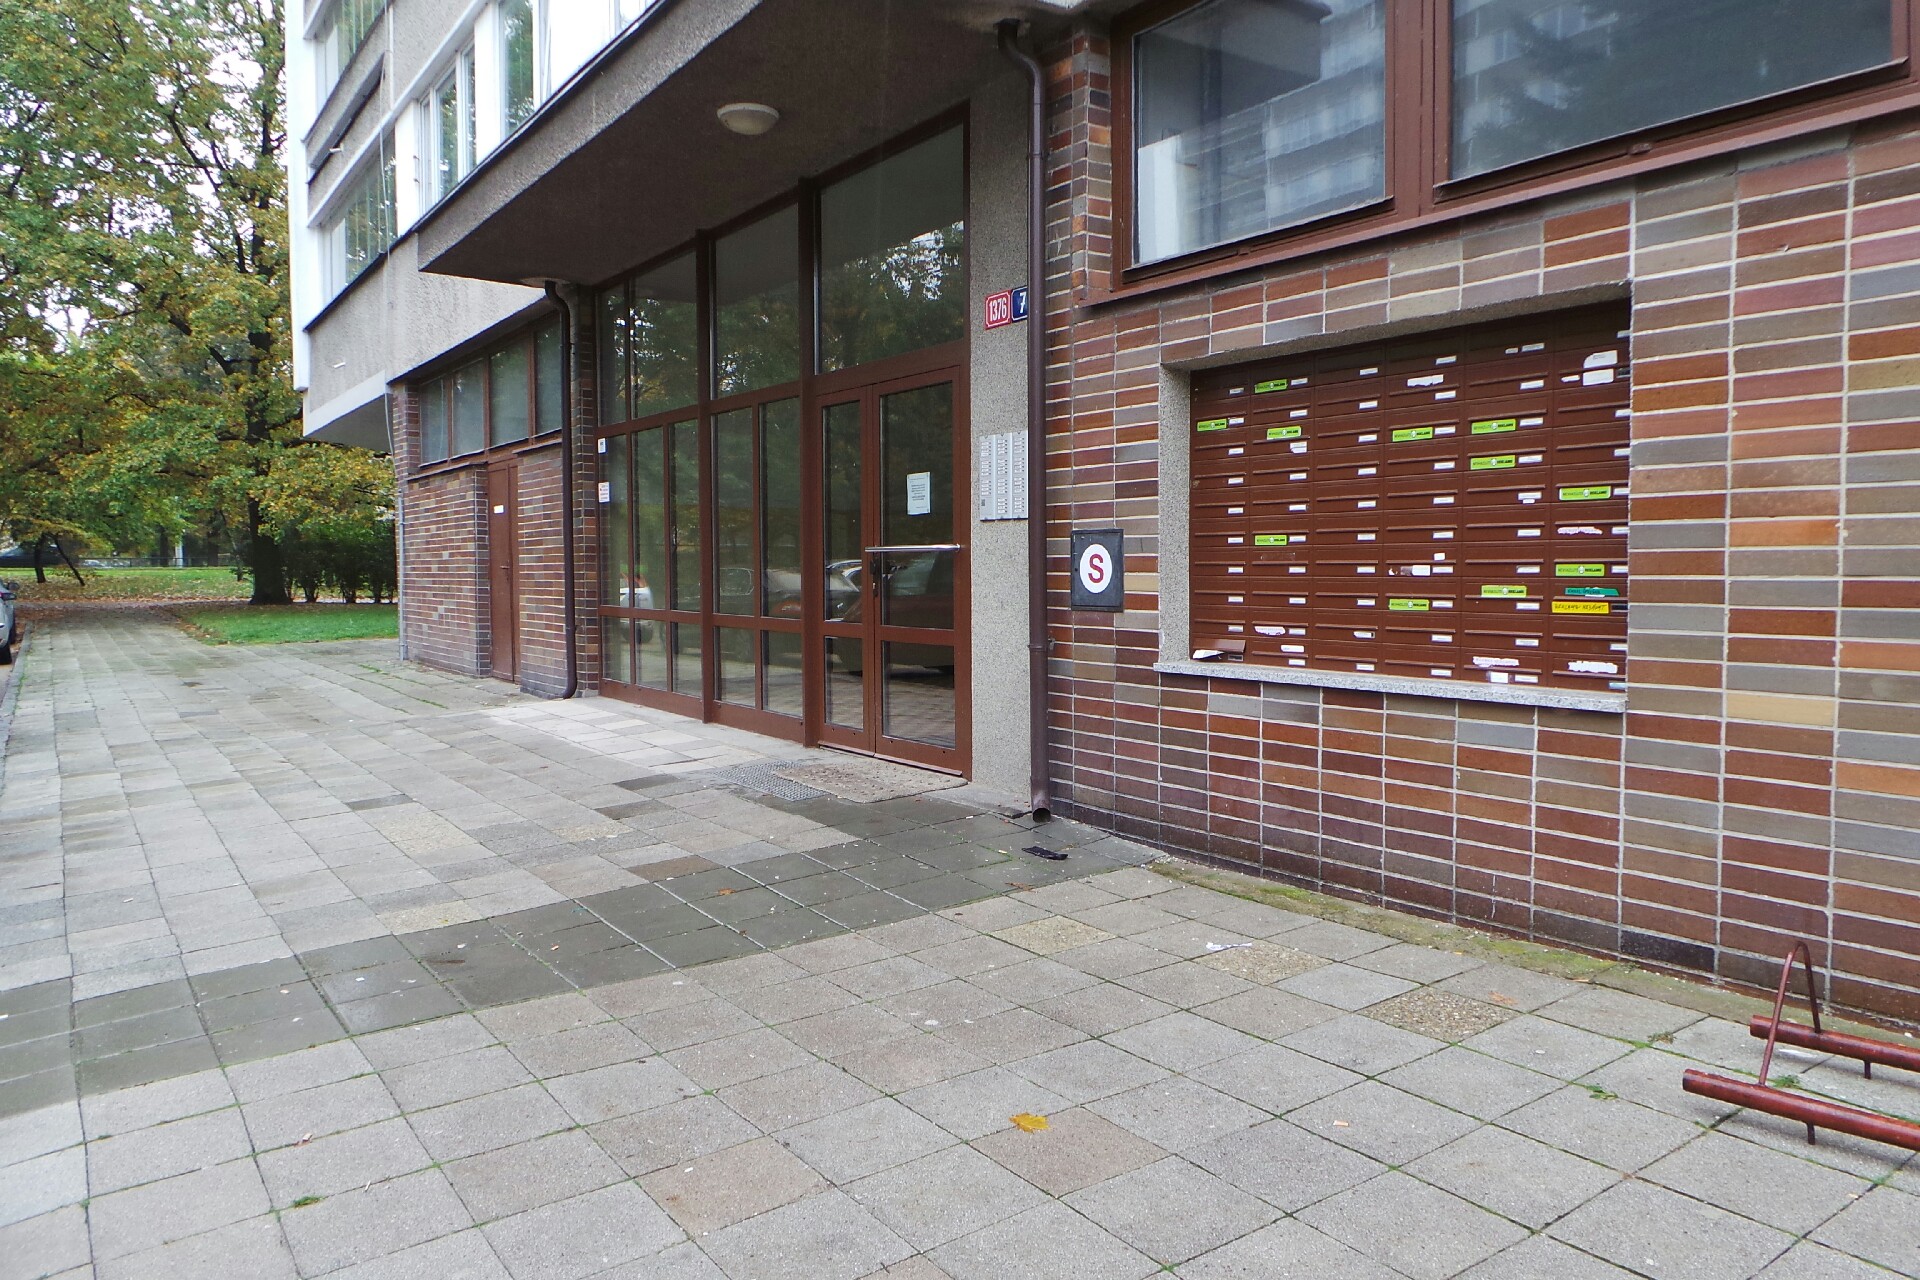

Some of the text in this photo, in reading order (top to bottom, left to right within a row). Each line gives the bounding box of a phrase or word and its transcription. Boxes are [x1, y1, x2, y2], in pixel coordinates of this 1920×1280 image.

[989, 297, 1007, 322] 1376
[1019, 291, 1027, 314] 7
[1087, 553, 1105, 584] S
